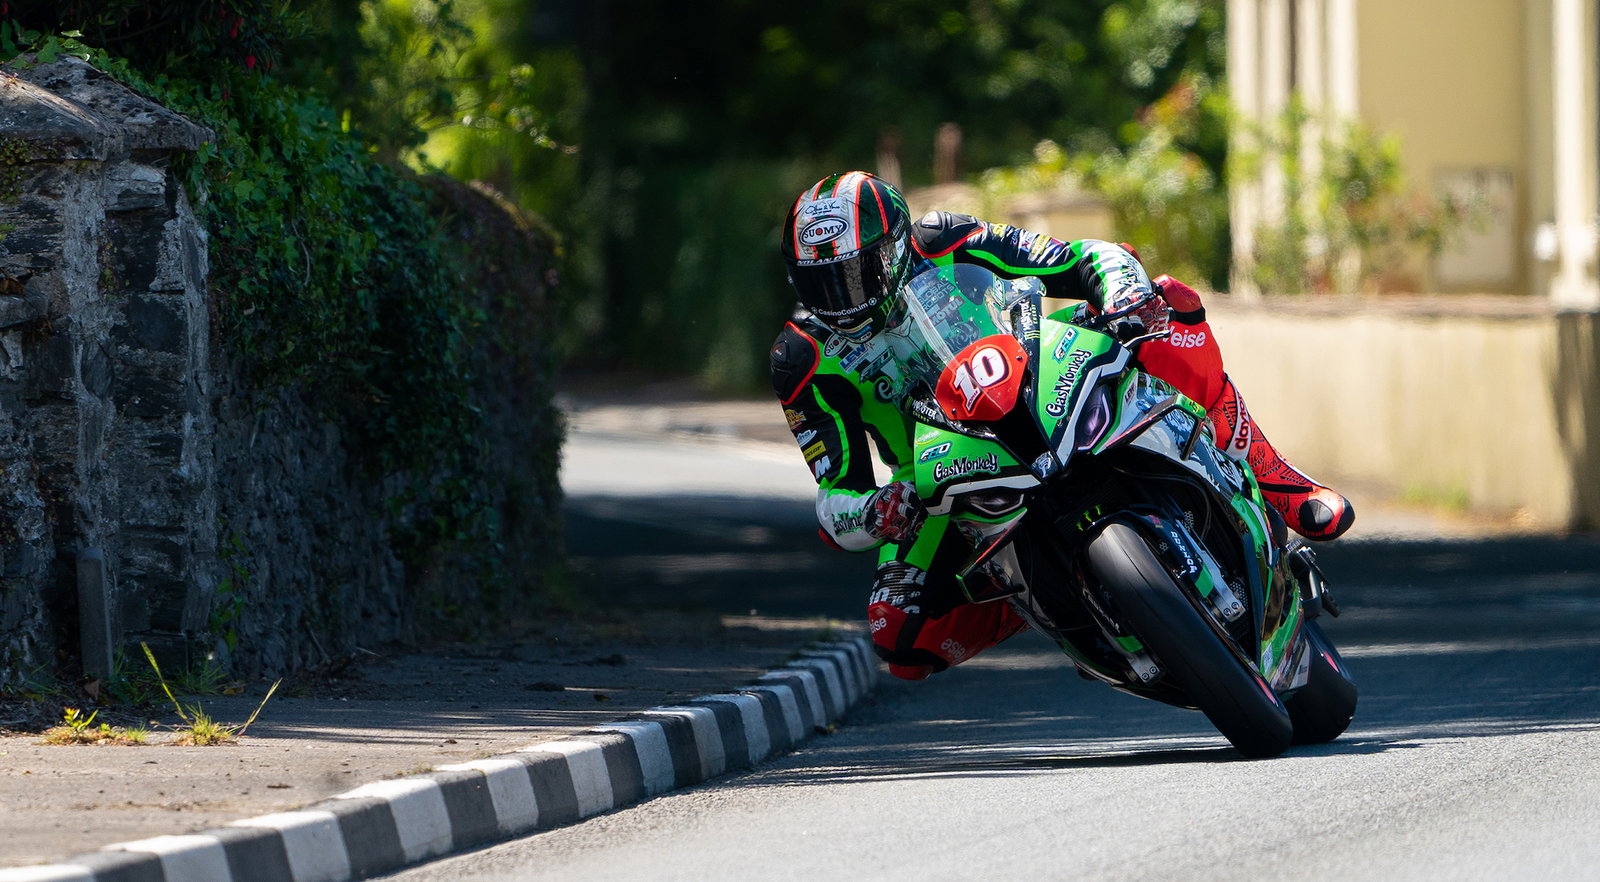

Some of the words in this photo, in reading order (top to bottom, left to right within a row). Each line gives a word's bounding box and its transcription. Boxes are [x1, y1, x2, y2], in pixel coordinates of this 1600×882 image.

[803, 224, 843, 239] SUOMY
[840, 343, 867, 370] LEW
[953, 347, 1007, 412] 10
[1045, 348, 1092, 417] GasMonkey
[934, 453, 998, 483] GasMonkey
